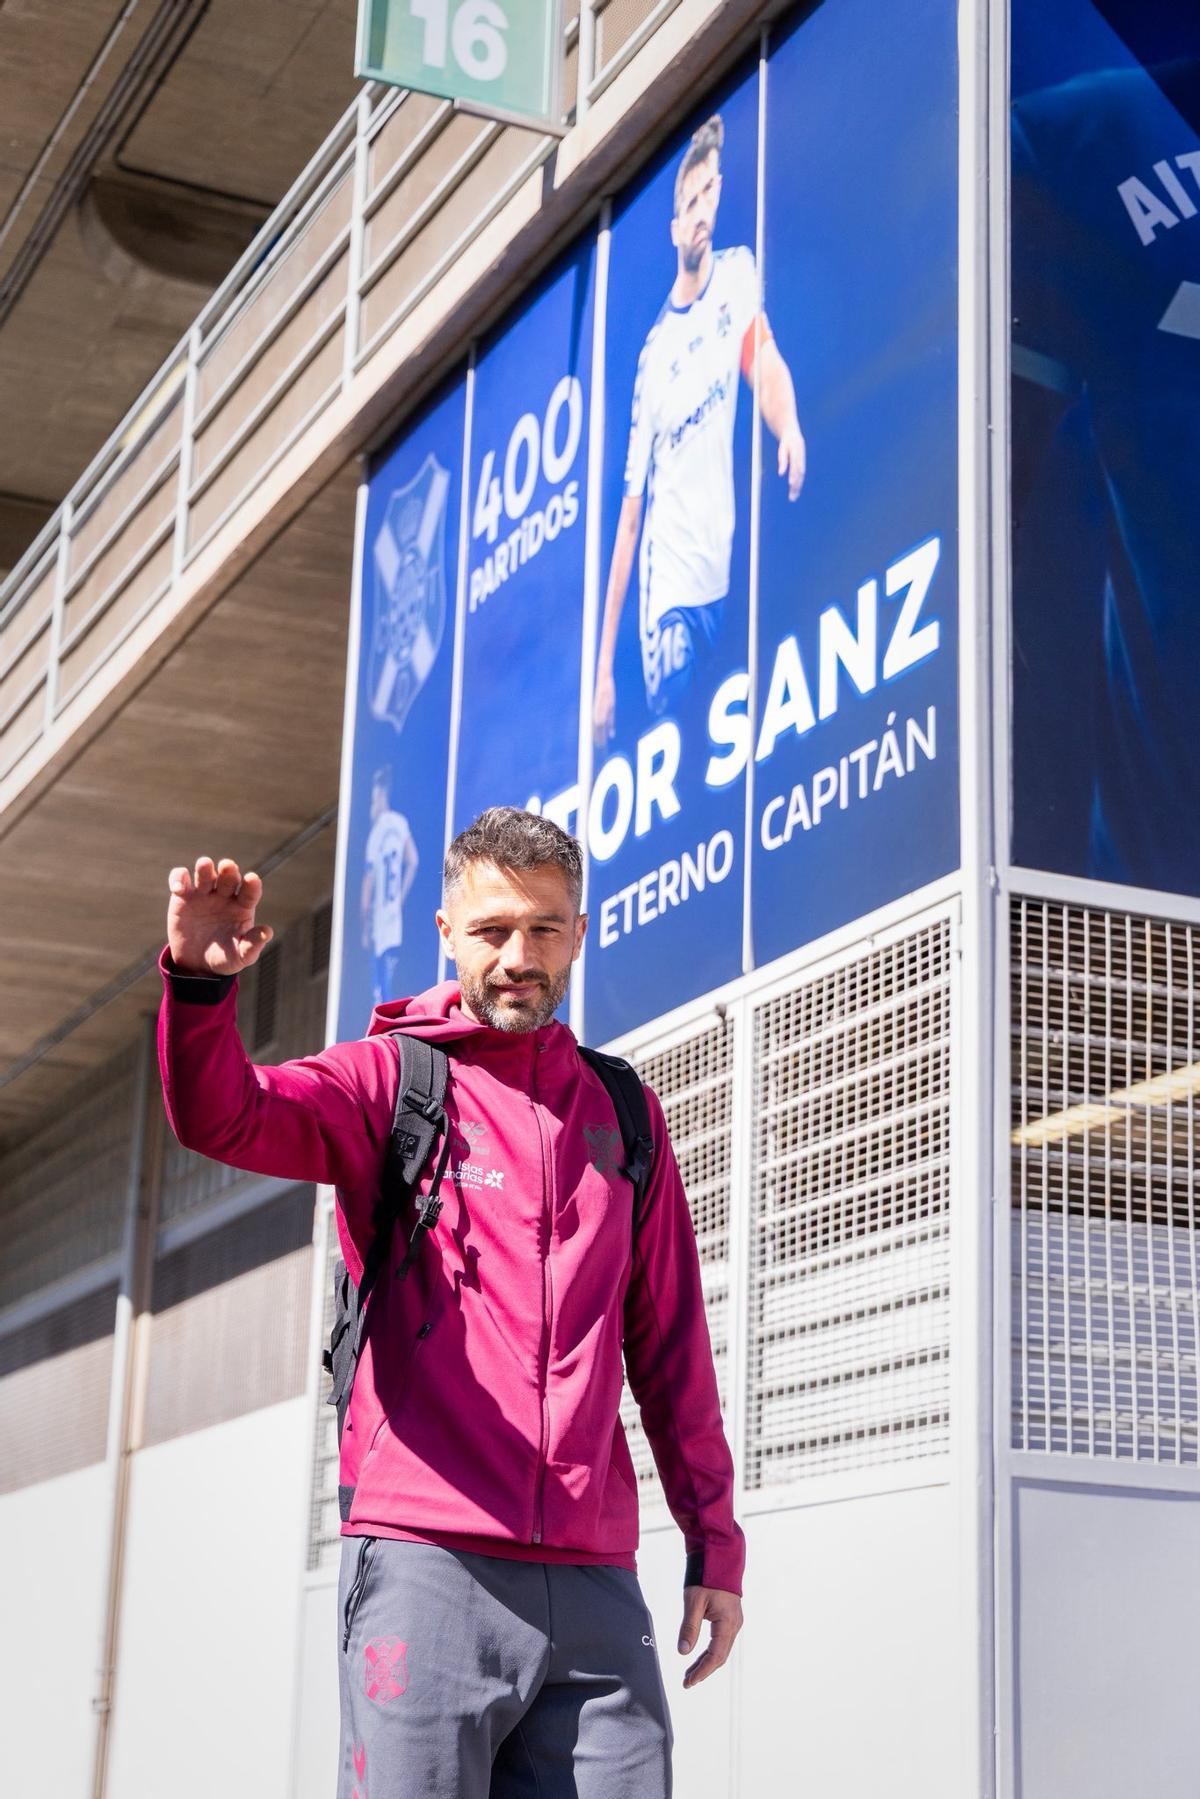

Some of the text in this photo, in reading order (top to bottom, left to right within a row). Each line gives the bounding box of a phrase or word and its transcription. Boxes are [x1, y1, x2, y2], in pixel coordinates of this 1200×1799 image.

[409, 0, 509, 82] 16
[472, 374, 583, 544] 400
[704, 537, 941, 788] SANZ
[600, 704, 937, 949] ETERNO CAPITÁN
[434, 1168, 484, 1185] anarias
[457, 1160, 484, 1176] Islas
